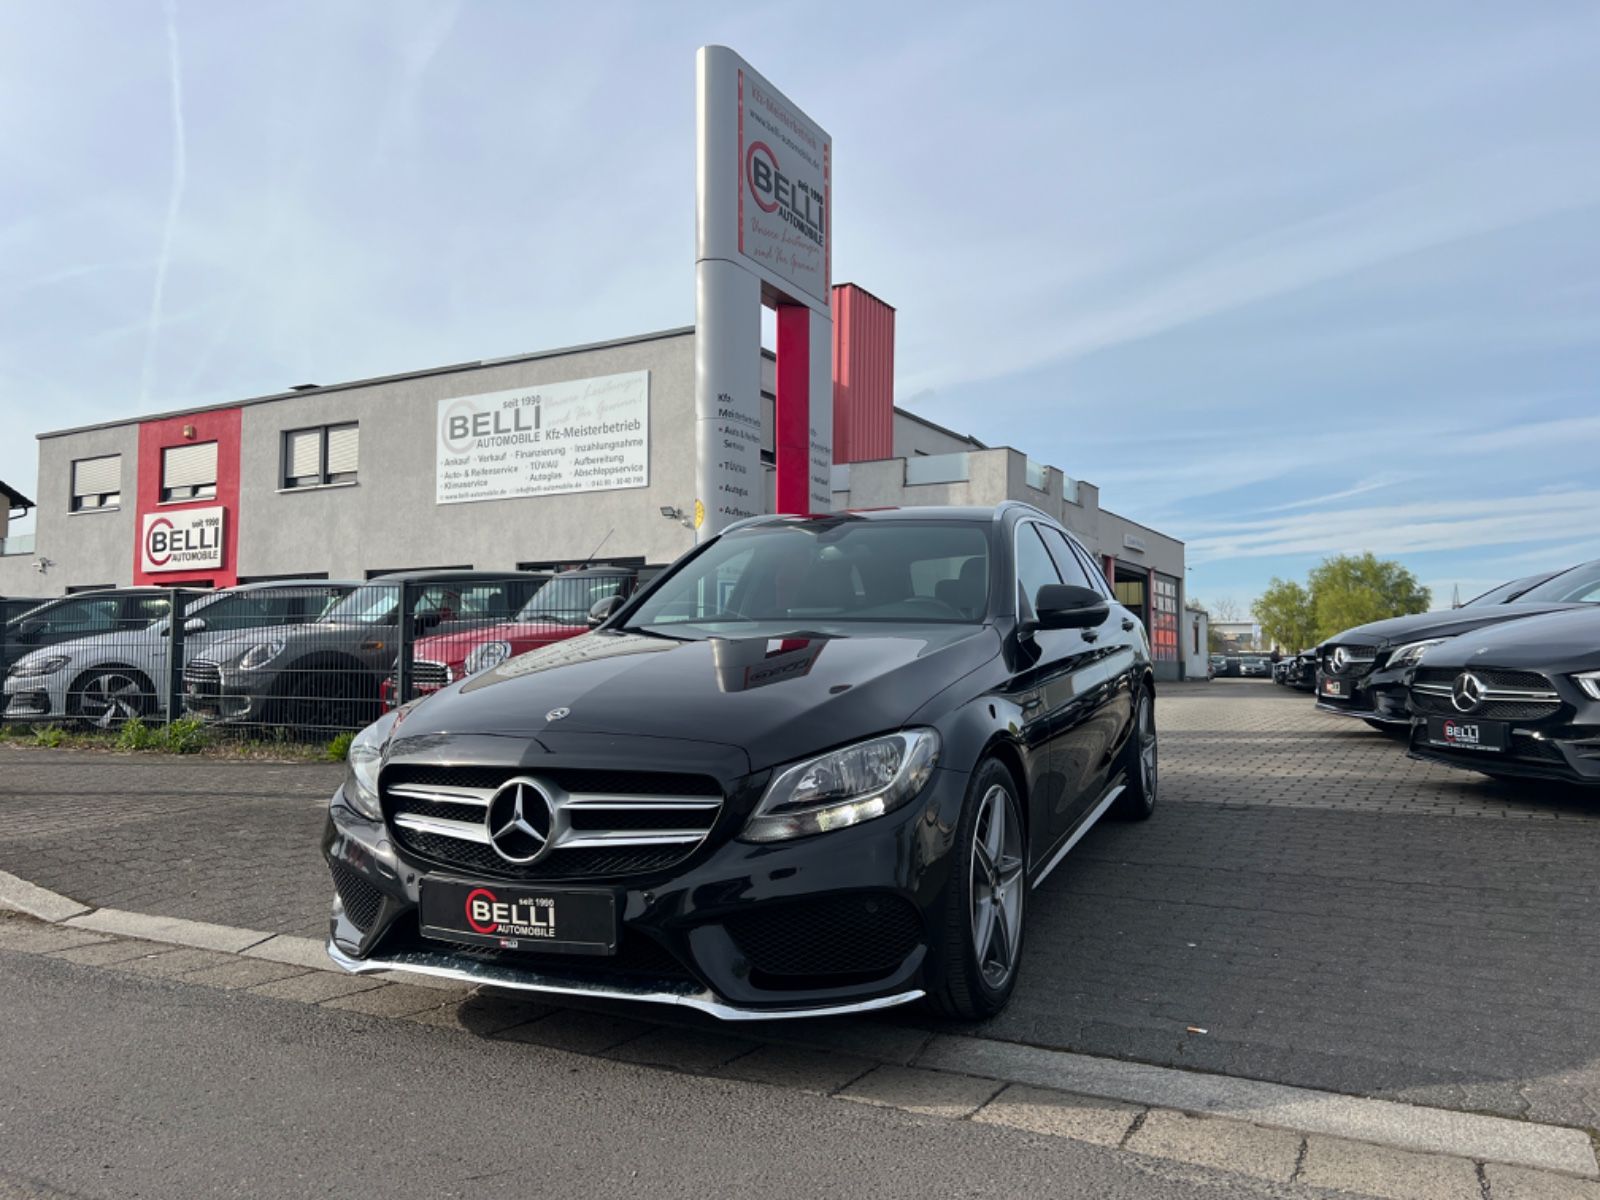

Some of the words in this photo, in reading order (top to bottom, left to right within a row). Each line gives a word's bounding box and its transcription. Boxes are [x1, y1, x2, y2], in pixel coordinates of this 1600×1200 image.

[754, 156, 823, 234] BELLI
[778, 206, 823, 247] AUTOMOBILE
[503, 400, 518, 409] seit
[449, 406, 541, 440] BELLI
[545, 418, 641, 441] Kfz-Meisterbetrieb
[476, 432, 541, 449] AUTOMOBILE
[478, 452, 507, 463] Verkauf
[515, 446, 566, 459] Finanzierung
[574, 438, 644, 453] Inzahlungsnahme
[574, 454, 624, 466] Aufbereitung
[574, 464, 644, 477] Abschleppservice
[152, 527, 219, 553] BELLI
[171, 550, 218, 562] AUTOMOBILE
[518, 898, 533, 906] seit
[472, 900, 555, 927] BELLI
[496, 925, 556, 937] AUTOMOBILE
